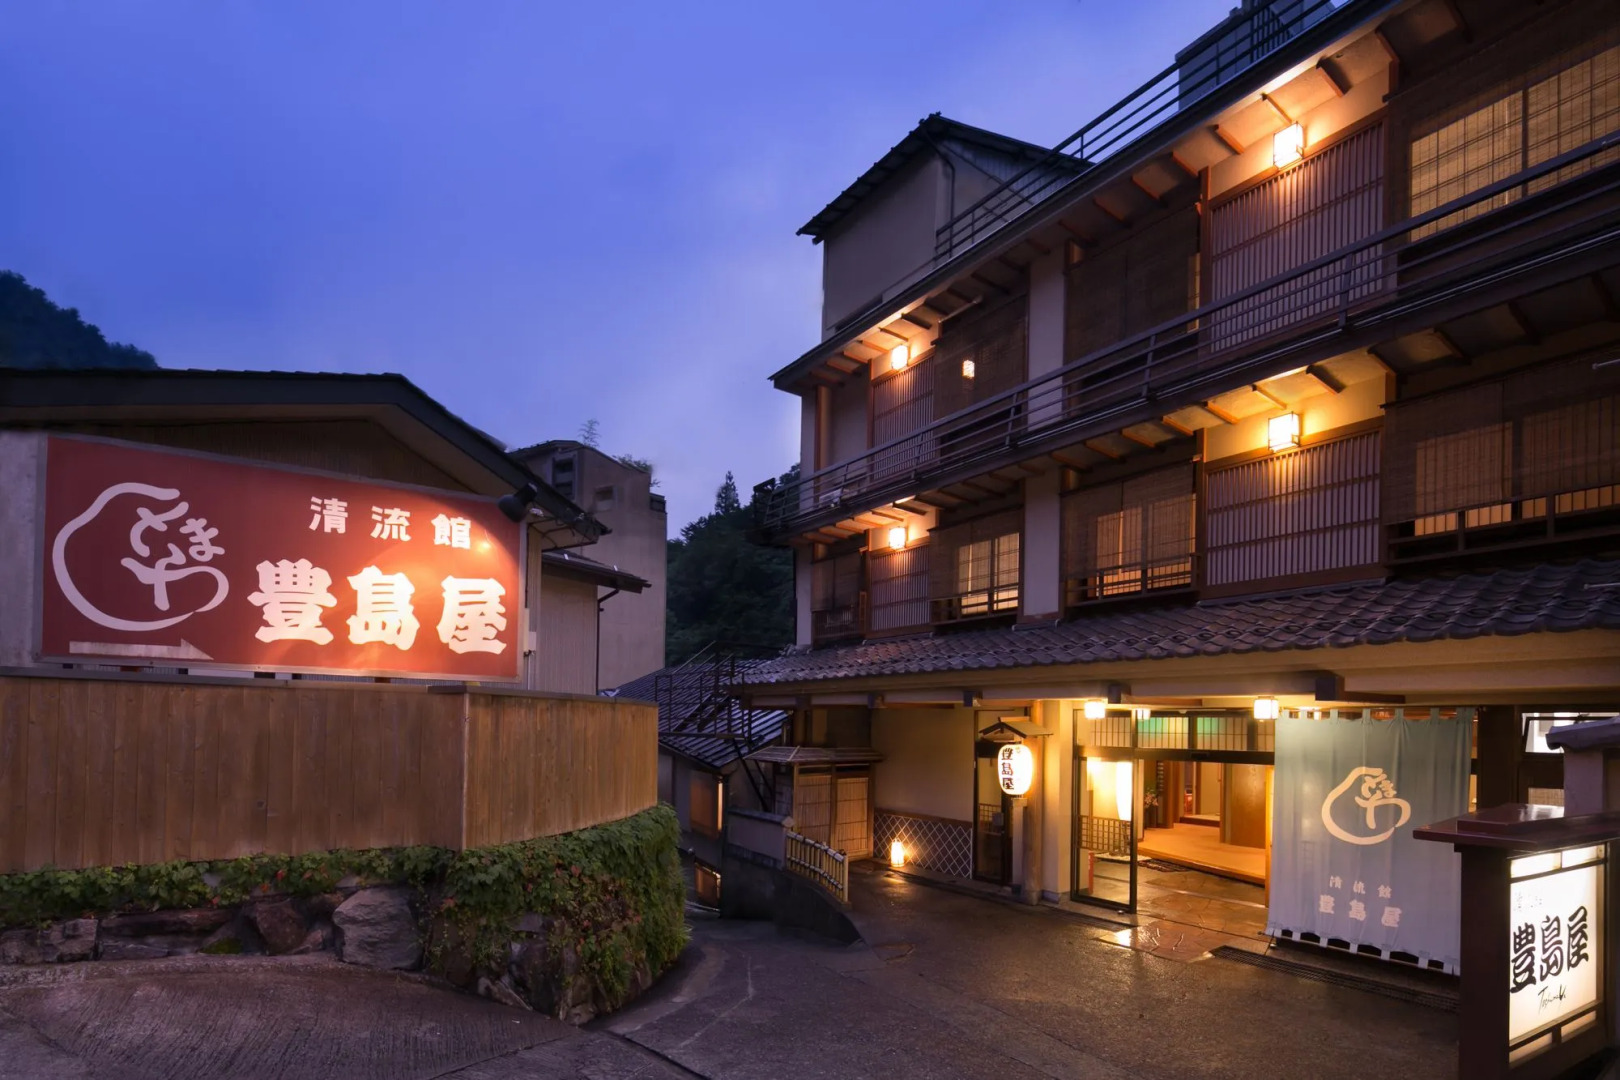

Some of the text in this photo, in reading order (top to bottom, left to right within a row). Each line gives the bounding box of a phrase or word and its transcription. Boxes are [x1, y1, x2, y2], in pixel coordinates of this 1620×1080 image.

[309, 496, 471, 549] 清流館
[247, 558, 507, 655] 豊島屋
[1319, 894, 1402, 928] 豊島屋
[1510, 905, 1589, 993] 豊島屋
